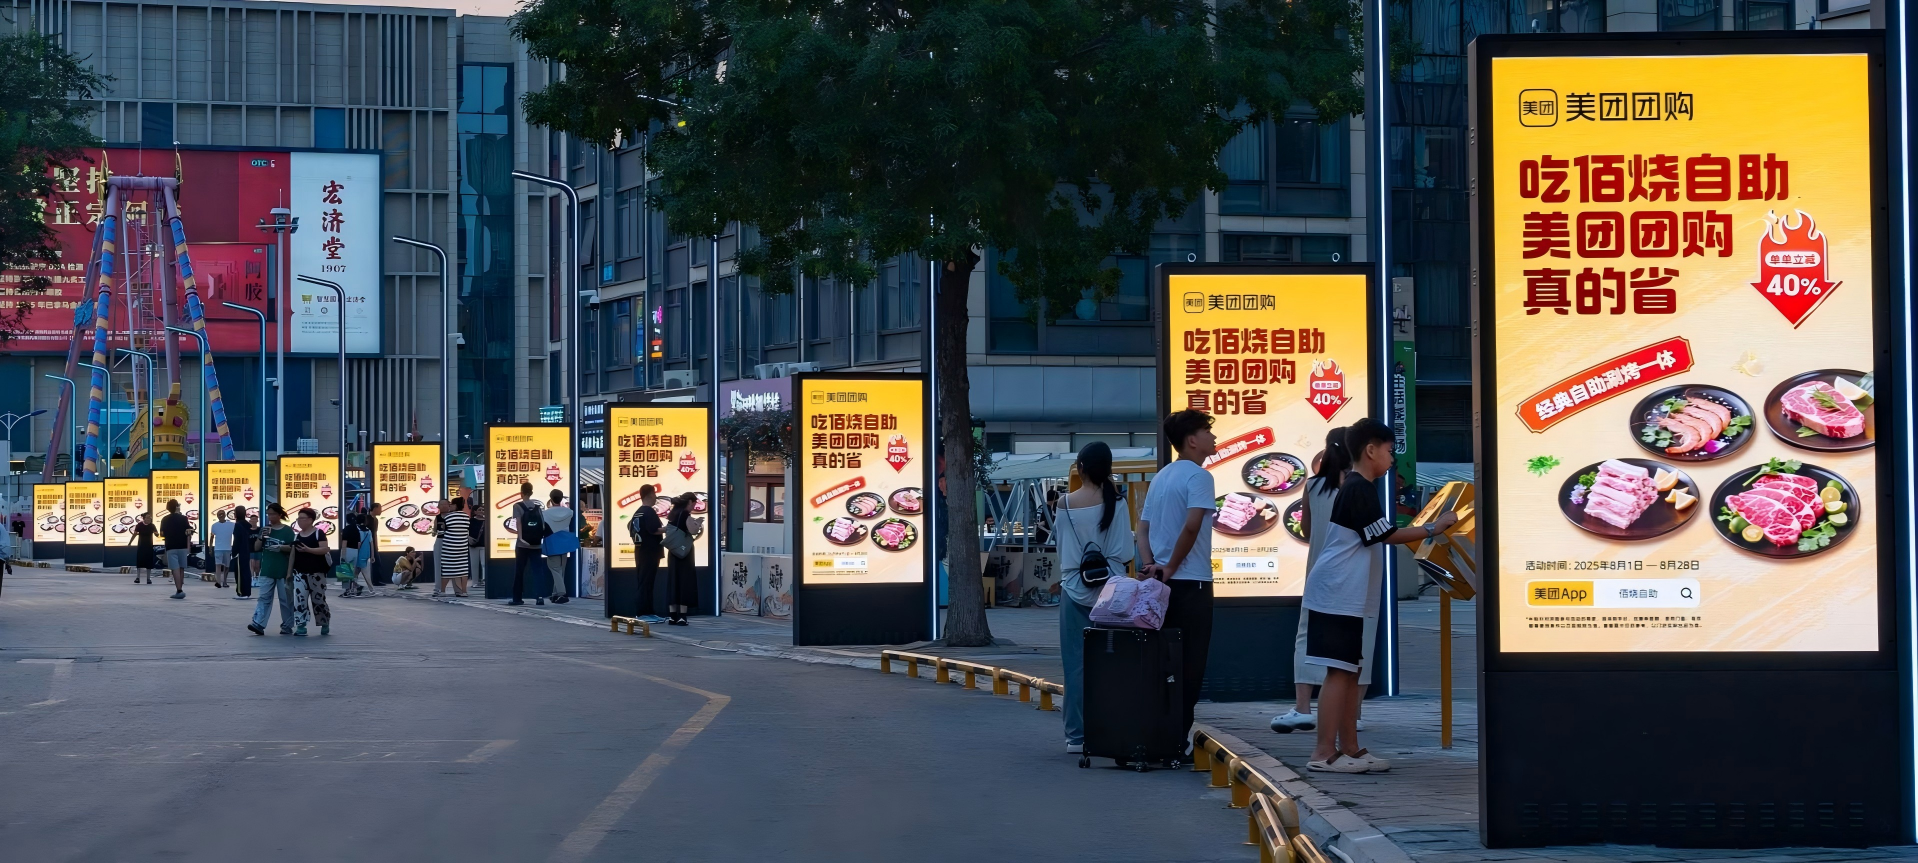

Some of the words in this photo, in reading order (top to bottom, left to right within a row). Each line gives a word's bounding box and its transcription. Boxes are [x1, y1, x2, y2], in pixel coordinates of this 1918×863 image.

[1522, 100, 1554, 116] 美团
[1566, 91, 1694, 122] 美团团购
[1519, 153, 1789, 204] 吃佰烧自助
[322, 180, 346, 260] 宏济堂
[1522, 209, 1733, 260] 美团团购
[321, 265, 347, 273] 1907
[1522, 266, 1680, 316] 真的省
[1766, 273, 1822, 297] 40%
[1208, 294, 1276, 311] 美团团购
[1184, 328, 1325, 354] 吃佰烧自助
[1185, 358, 1296, 385] 美团团购
[1534, 348, 1677, 421] 经典自助涮烤一体
[1186, 389, 1268, 415] 真的省
[1312, 392, 1342, 405] 40%
[811, 414, 897, 430] 吃佰烧自助
[618, 434, 687, 447] 吃佰烧自助
[812, 433, 879, 449] 美团团购
[618, 449, 673, 462] 美团团购
[812, 452, 862, 469] 真的省
[889, 454, 908, 463] 40%
[618, 465, 659, 478] 真的省
[1534, 587, 1588, 602] 美团App
[1619, 588, 1659, 599] 佰烧自助
